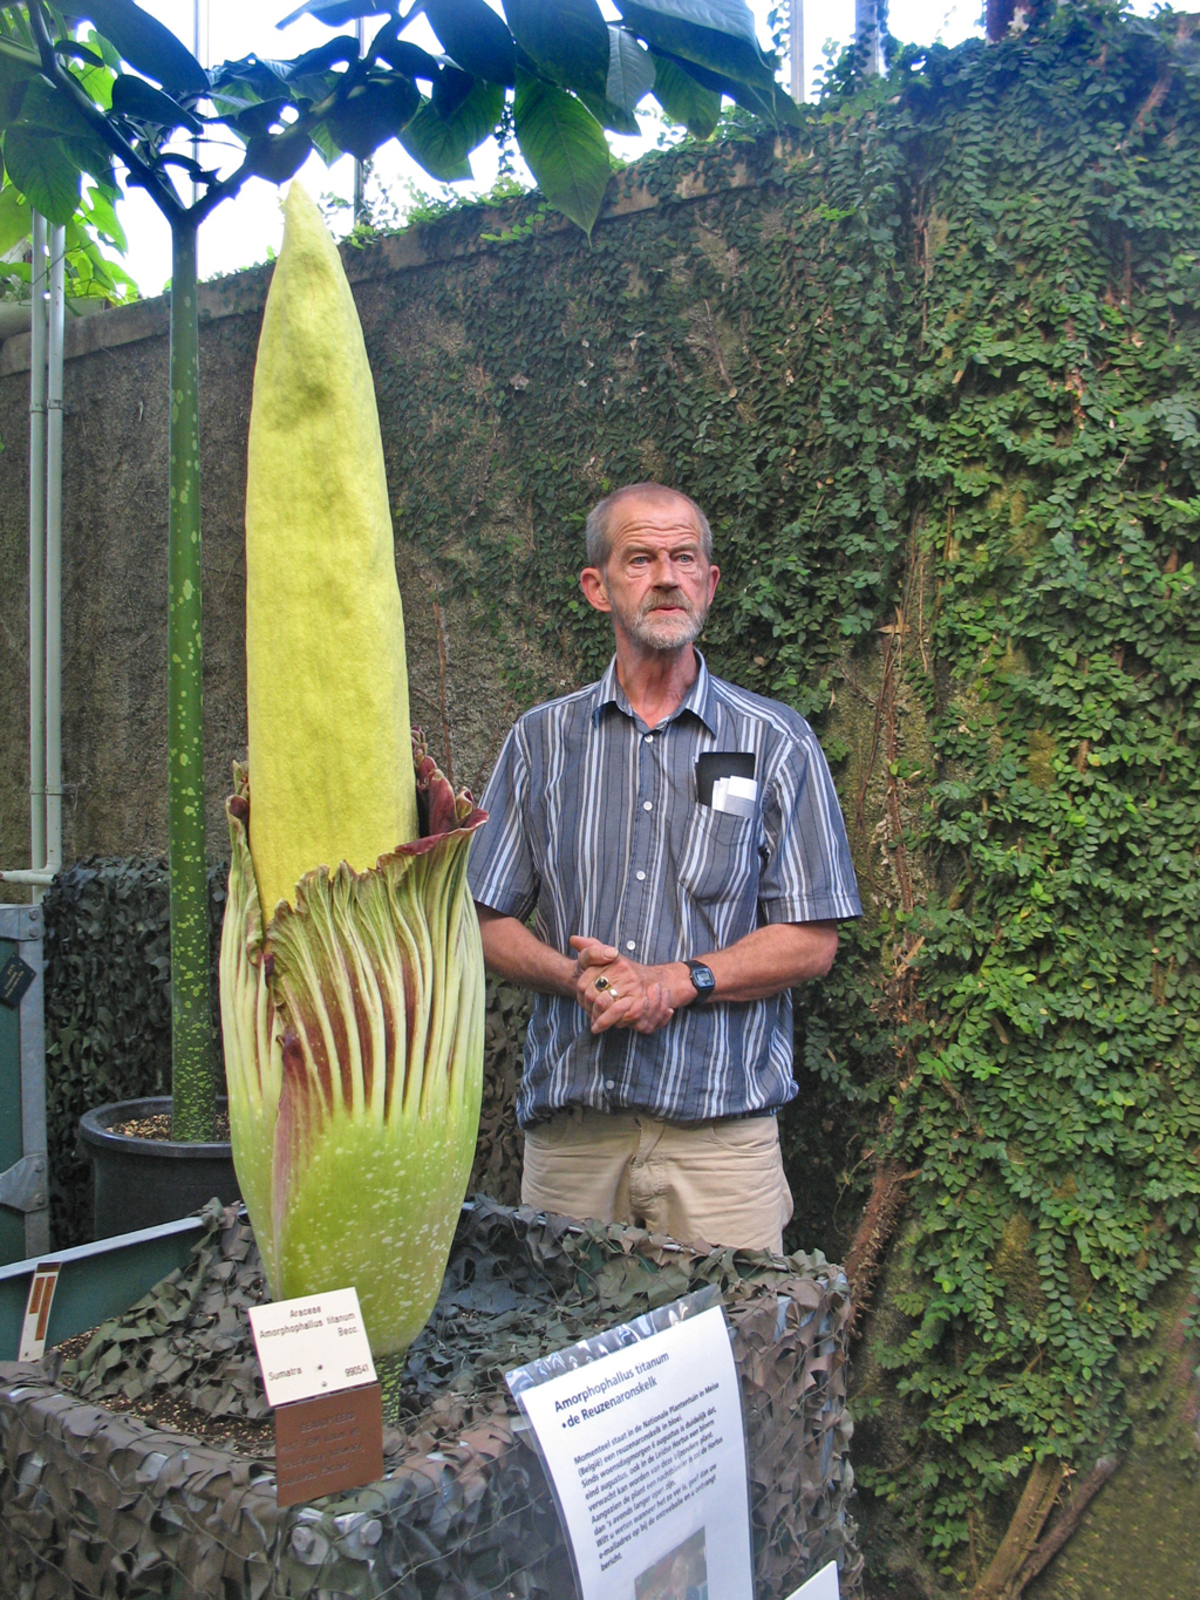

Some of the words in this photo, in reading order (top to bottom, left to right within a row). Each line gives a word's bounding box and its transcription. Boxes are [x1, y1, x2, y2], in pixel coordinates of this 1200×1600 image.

[260, 1320, 323, 1338] Amorphophallus
[326, 1313, 355, 1324] titanum
[290, 1306, 321, 1318] Araceae
[337, 1326, 359, 1337] Becc.
[268, 1367, 302, 1381] Sumatra
[345, 1364, 369, 1377] 990541
[555, 1370, 634, 1413] Amorphophallus
[635, 1353, 669, 1374] titanum
[567, 1415, 580, 1427] de
[581, 1376, 657, 1420] Reuzenaronskelk
[574, 1440, 611, 1465] Momenteel
[611, 1432, 627, 1446] staat
[634, 1425, 642, 1433] de
[643, 1410, 669, 1428] Nationale
[669, 1394, 699, 1414] Plantentuin
[578, 1458, 602, 1477] (België)
[604, 1452, 616, 1463] een
[616, 1426, 661, 1456] reuzenaronskelk
[581, 1474, 599, 1488] Sinds
[600, 1445, 652, 1478] woensdagmorgen
[656, 1429, 680, 1446] augustus
[685, 1412, 707, 1429] duidelijk
[585, 1486, 600, 1500] eind
[630, 1463, 640, 1474] ook
[641, 1460, 647, 1468] in
[648, 1456, 654, 1464] de
[672, 1435, 689, 1449] Hortus
[689, 1429, 699, 1438] een
[588, 1490, 617, 1512] verwacht
[617, 1484, 628, 1495] kan
[629, 1471, 650, 1488] worden
[650, 1465, 660, 1474] van
[661, 1457, 673, 1468] deze
[592, 1501, 622, 1524] Aangezien
[623, 1496, 630, 1505] de
[631, 1485, 646, 1501] plant
[646, 1480, 657, 1490] een
[701, 1447, 707, 1455] de
[594, 1525, 606, 1536] dan
[613, 1507, 633, 1524] avonds
[633, 1495, 650, 1510] langer
[651, 1487, 664, 1499] open
[596, 1535, 609, 1547] Wilt
[615, 1520, 633, 1535] weten
[633, 1504, 656, 1523] wanneer
[656, 1497, 666, 1508] het
[666, 1493, 673, 1502] zo
[673, 1487, 681, 1497] ver
[599, 1534, 632, 1559] e-mailadres
[632, 1528, 640, 1537] op
[640, 1522, 648, 1532] bij
[648, 1518, 655, 1526] de
[656, 1498, 683, 1521] entreebalie
[684, 1493, 691, 1501] en
